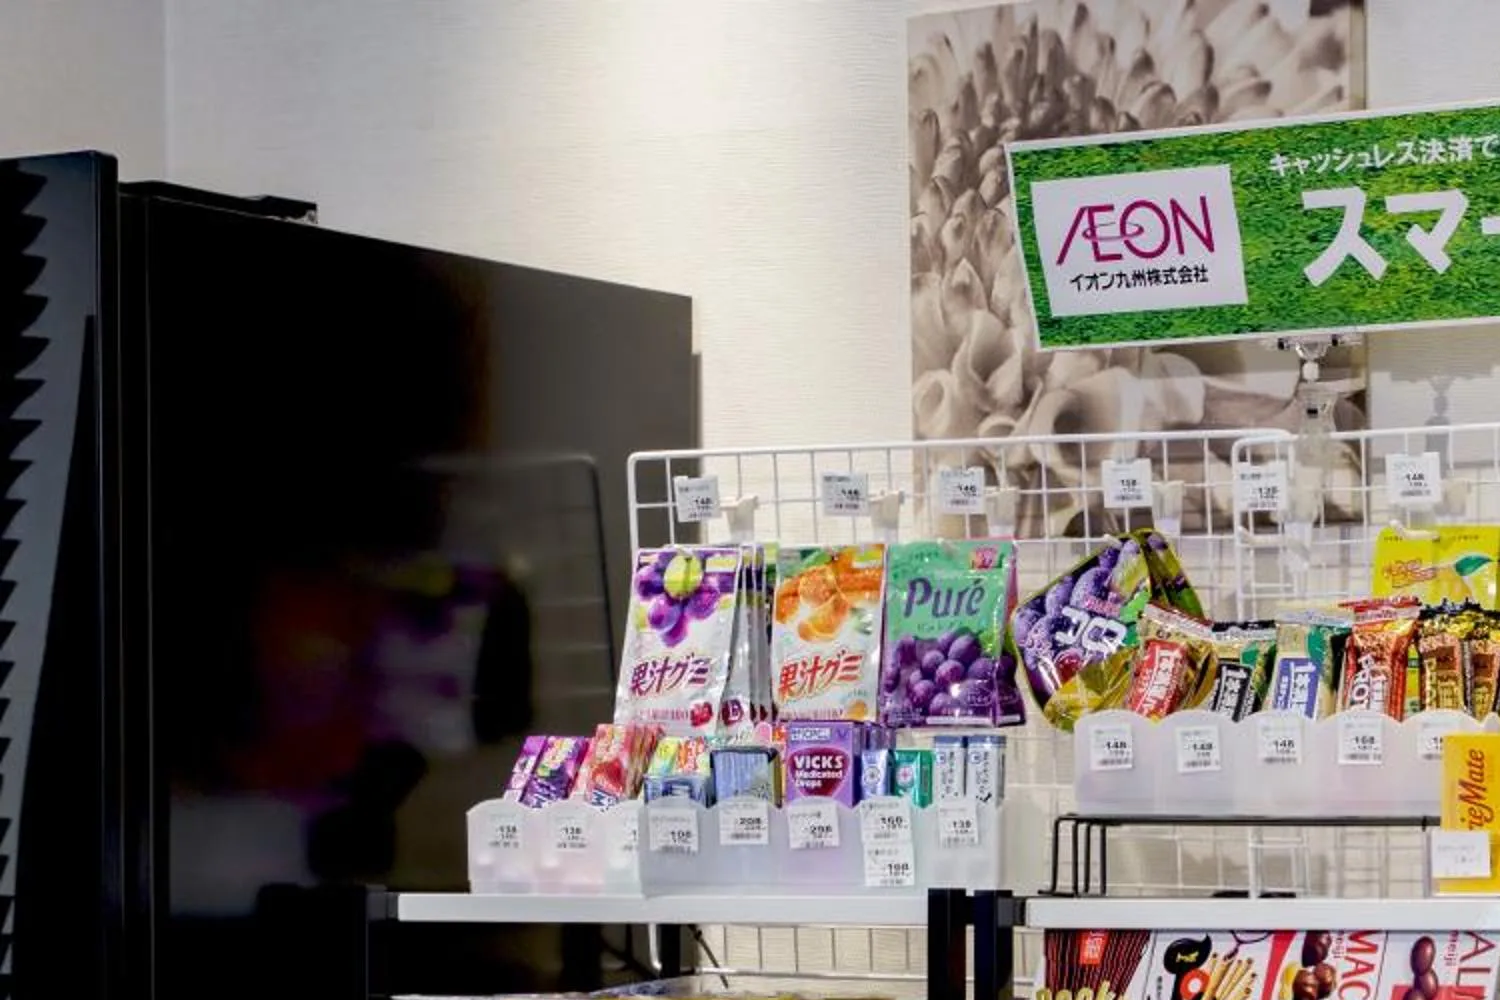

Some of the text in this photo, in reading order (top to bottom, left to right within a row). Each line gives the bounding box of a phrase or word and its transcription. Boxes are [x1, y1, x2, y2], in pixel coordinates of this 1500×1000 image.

[1069, 265, 1209, 292] イオン九州株式会社
[904, 577, 985, 620] Puré
[630, 651, 713, 696] 果汁グミ
[777, 648, 864, 700] 果汁グミ
[792, 754, 844, 770] VICKS
[794, 769, 843, 780] Medicated
[1457, 747, 1494, 832] rieMate
